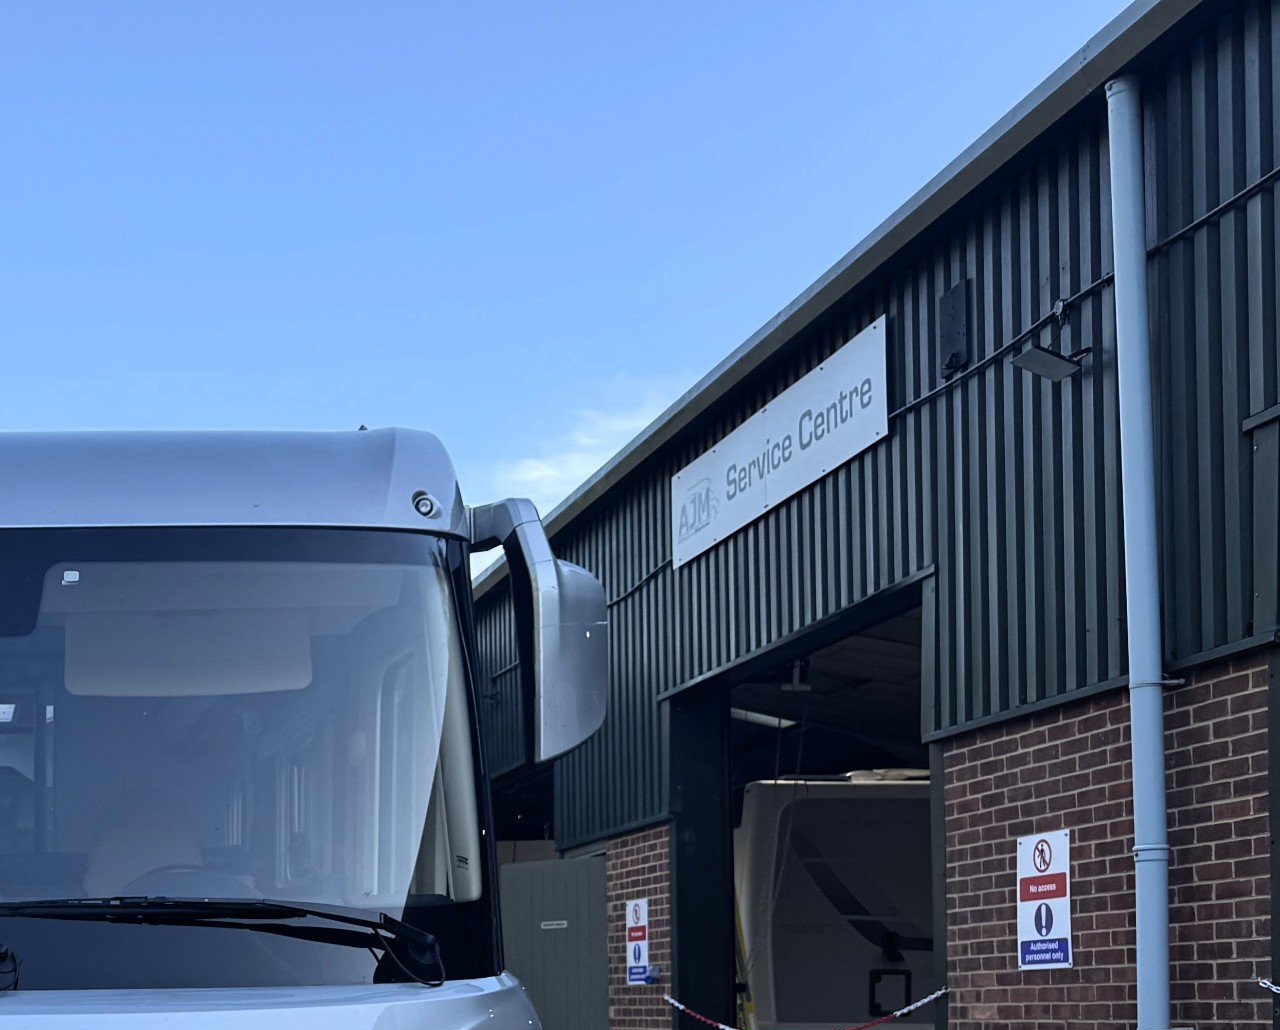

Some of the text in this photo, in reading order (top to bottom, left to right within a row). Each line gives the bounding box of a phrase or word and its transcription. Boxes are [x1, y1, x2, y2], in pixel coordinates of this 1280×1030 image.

[678, 377, 872, 538] AJM Service Centre
[1029, 884, 1057, 893] No access
[1030, 941, 1059, 951] Authorised
[1025, 950, 1064, 963] personnel only
